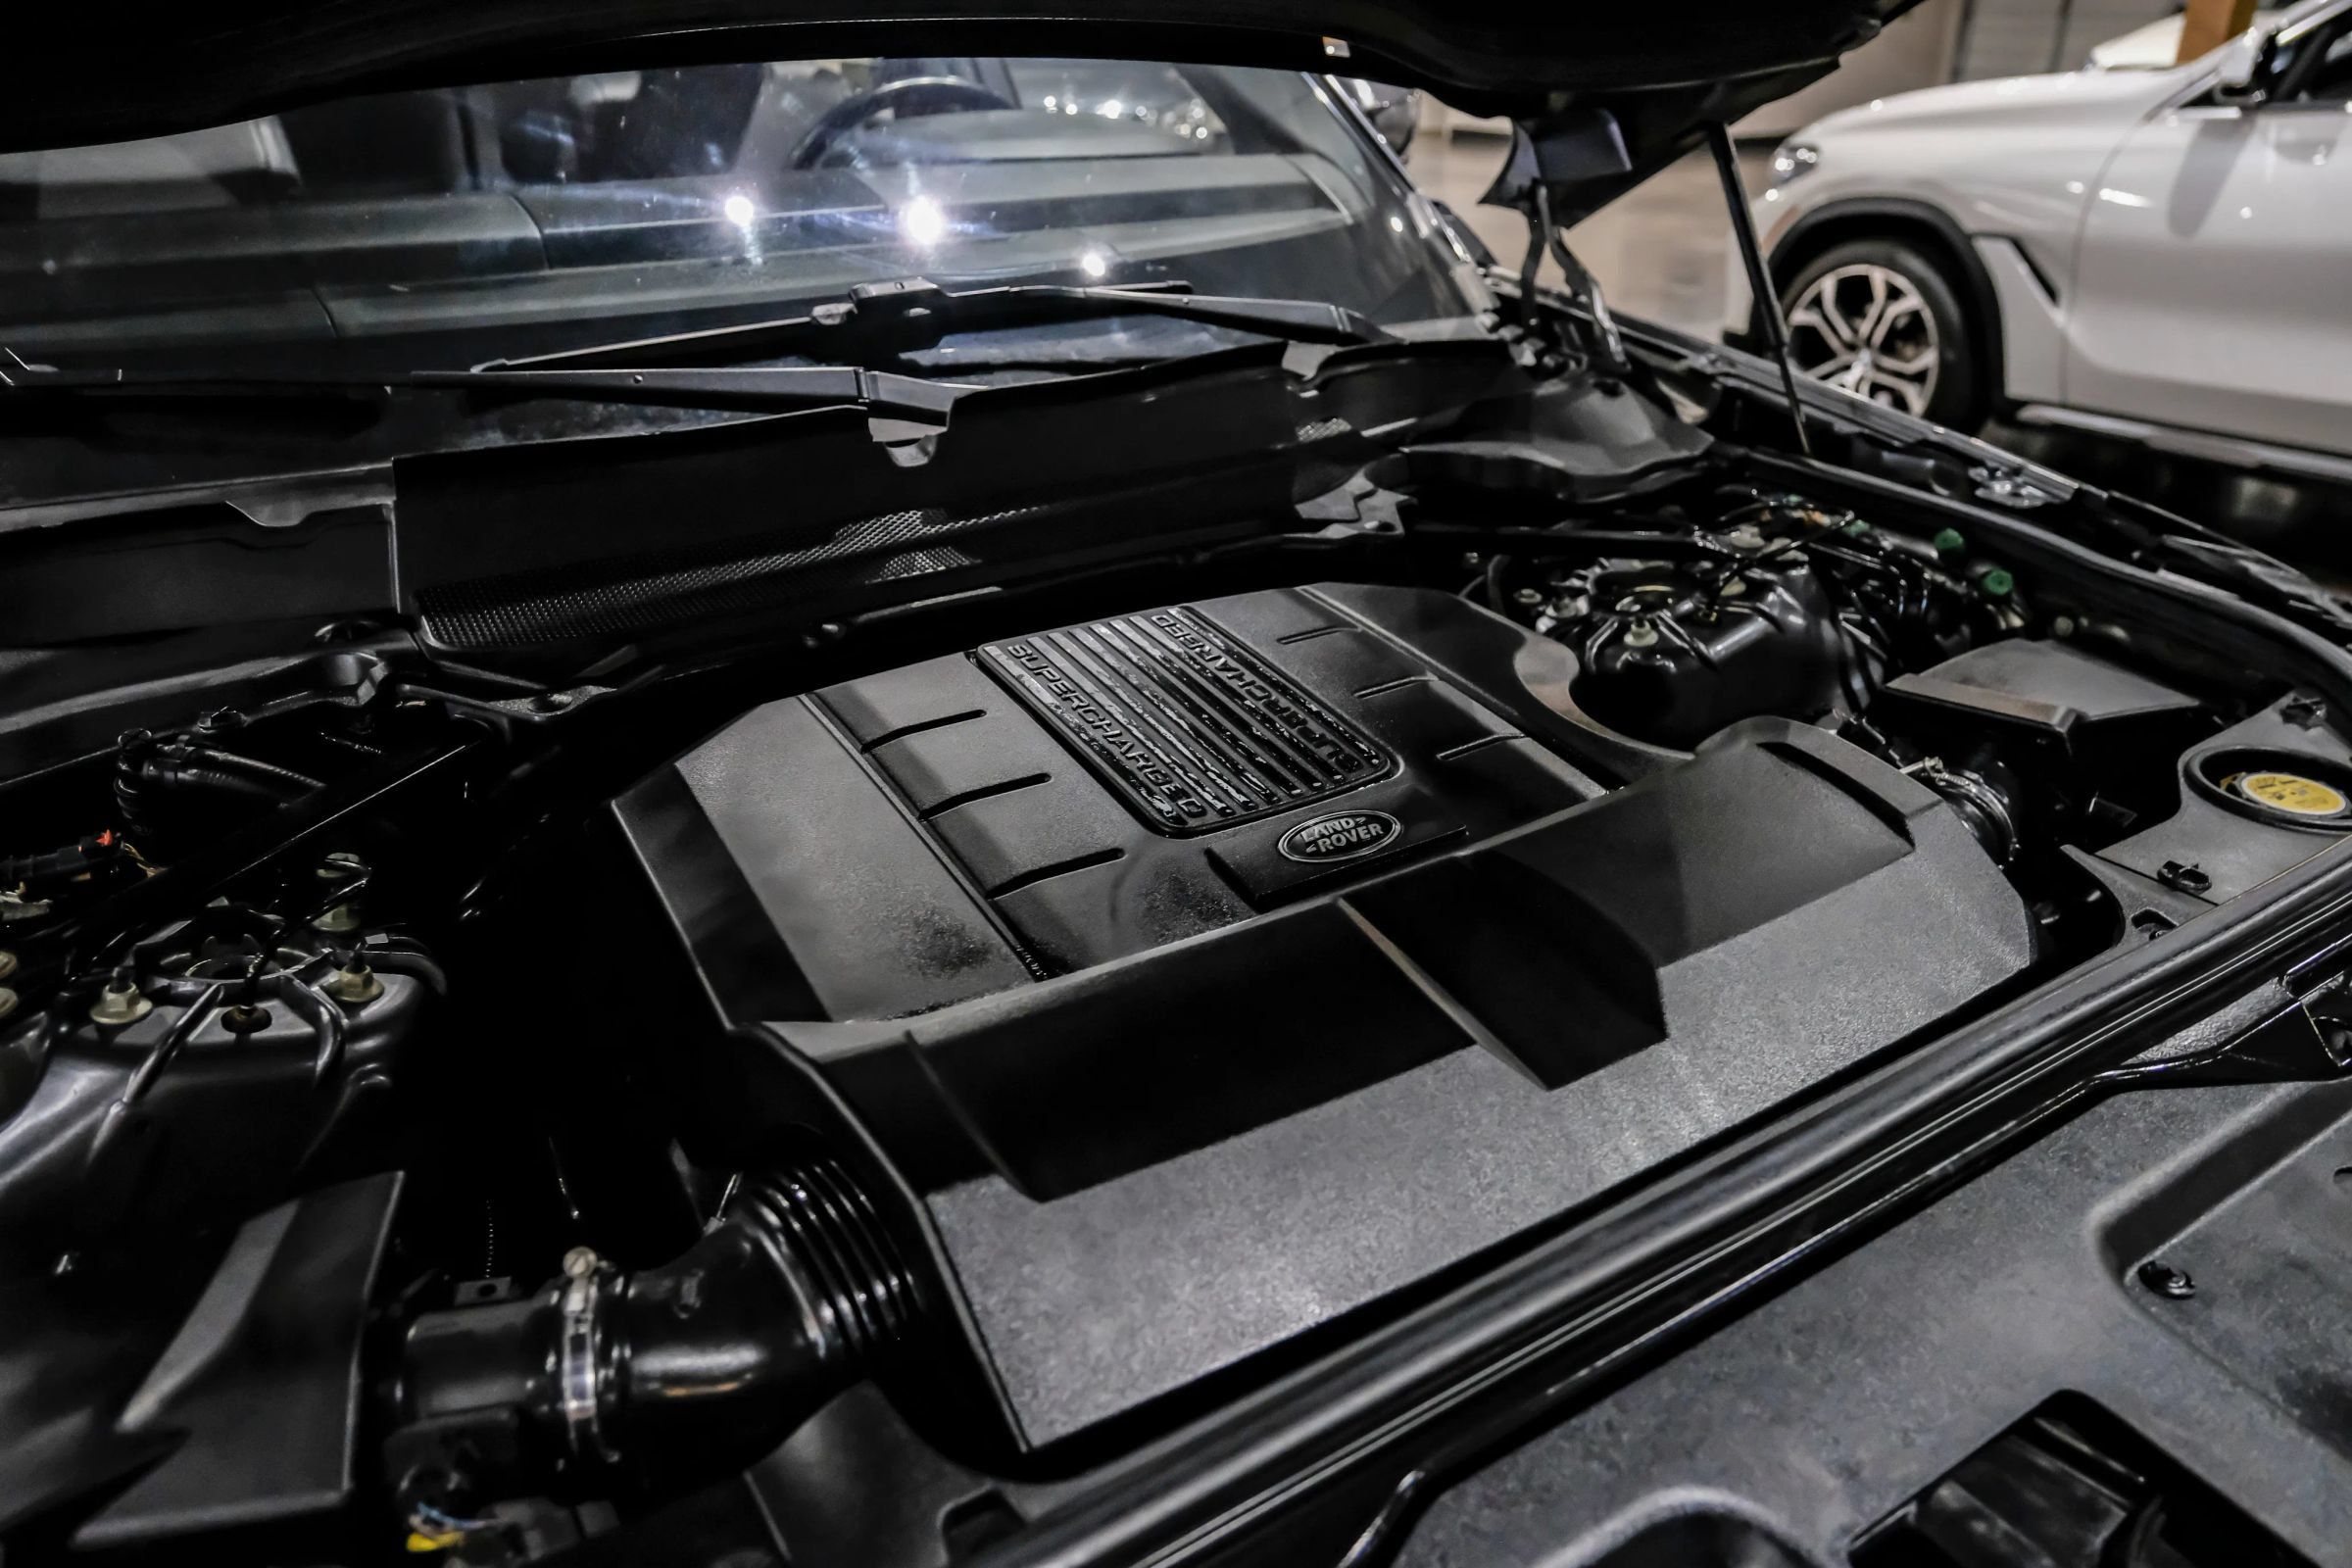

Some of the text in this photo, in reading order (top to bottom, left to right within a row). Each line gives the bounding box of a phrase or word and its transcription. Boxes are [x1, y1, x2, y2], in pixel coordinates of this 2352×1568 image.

[1007, 644, 1207, 818] SUPERCHARGED
[1300, 817, 1355, 843] LAND
[1317, 823, 1384, 853] ROVER
